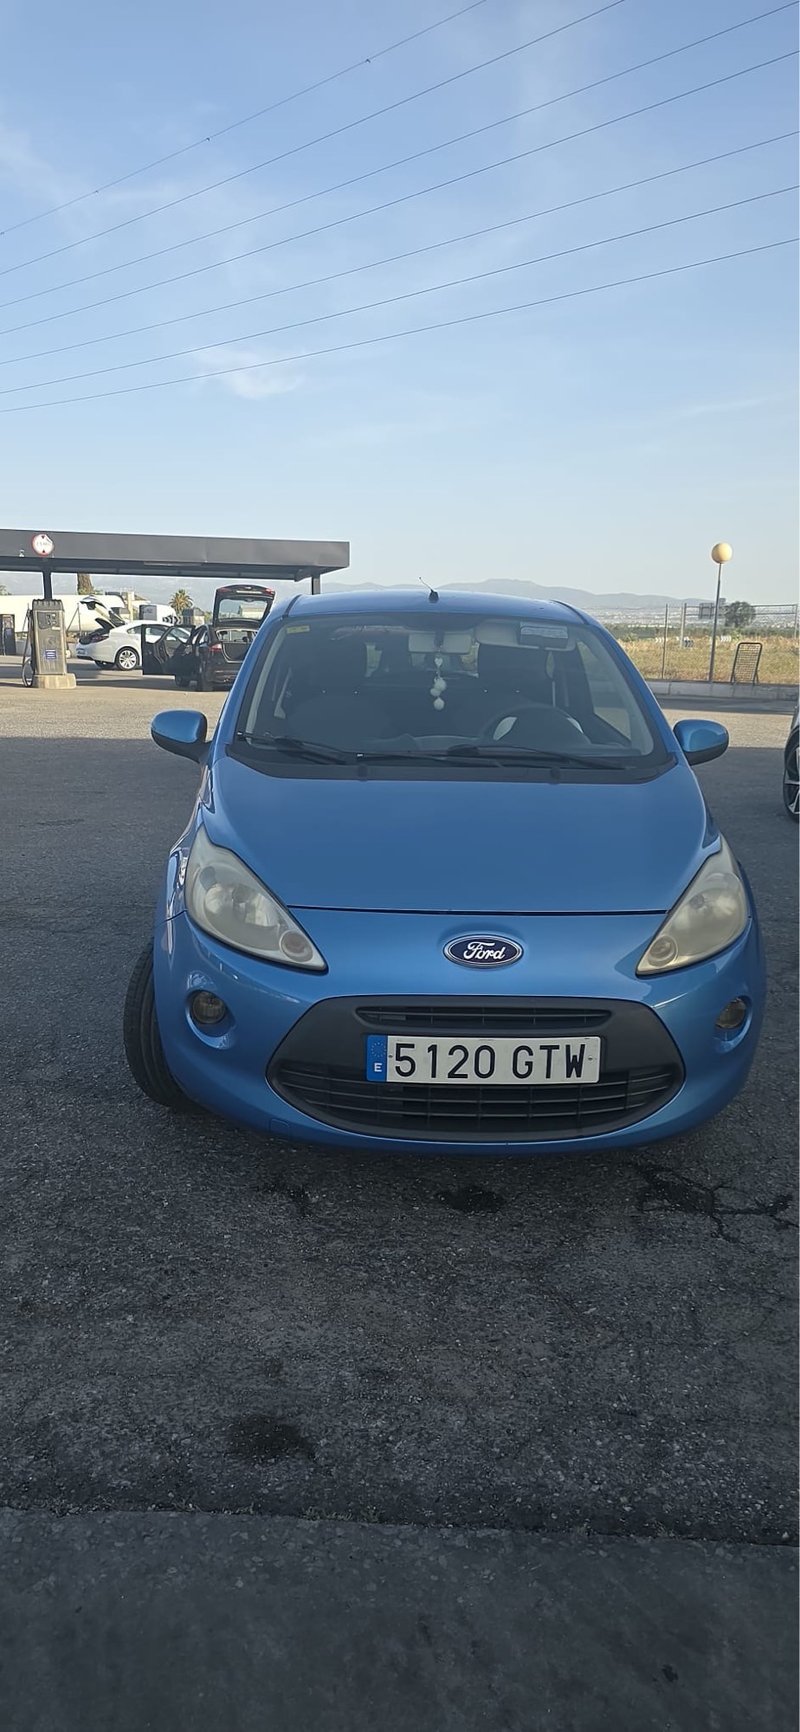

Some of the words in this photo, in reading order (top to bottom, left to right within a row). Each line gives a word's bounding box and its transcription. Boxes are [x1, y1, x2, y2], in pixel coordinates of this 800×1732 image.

[463, 941, 506, 960] Ford
[374, 1062, 382, 1072] E
[395, 1043, 496, 1079] 5120
[512, 1044, 586, 1079] GTW
